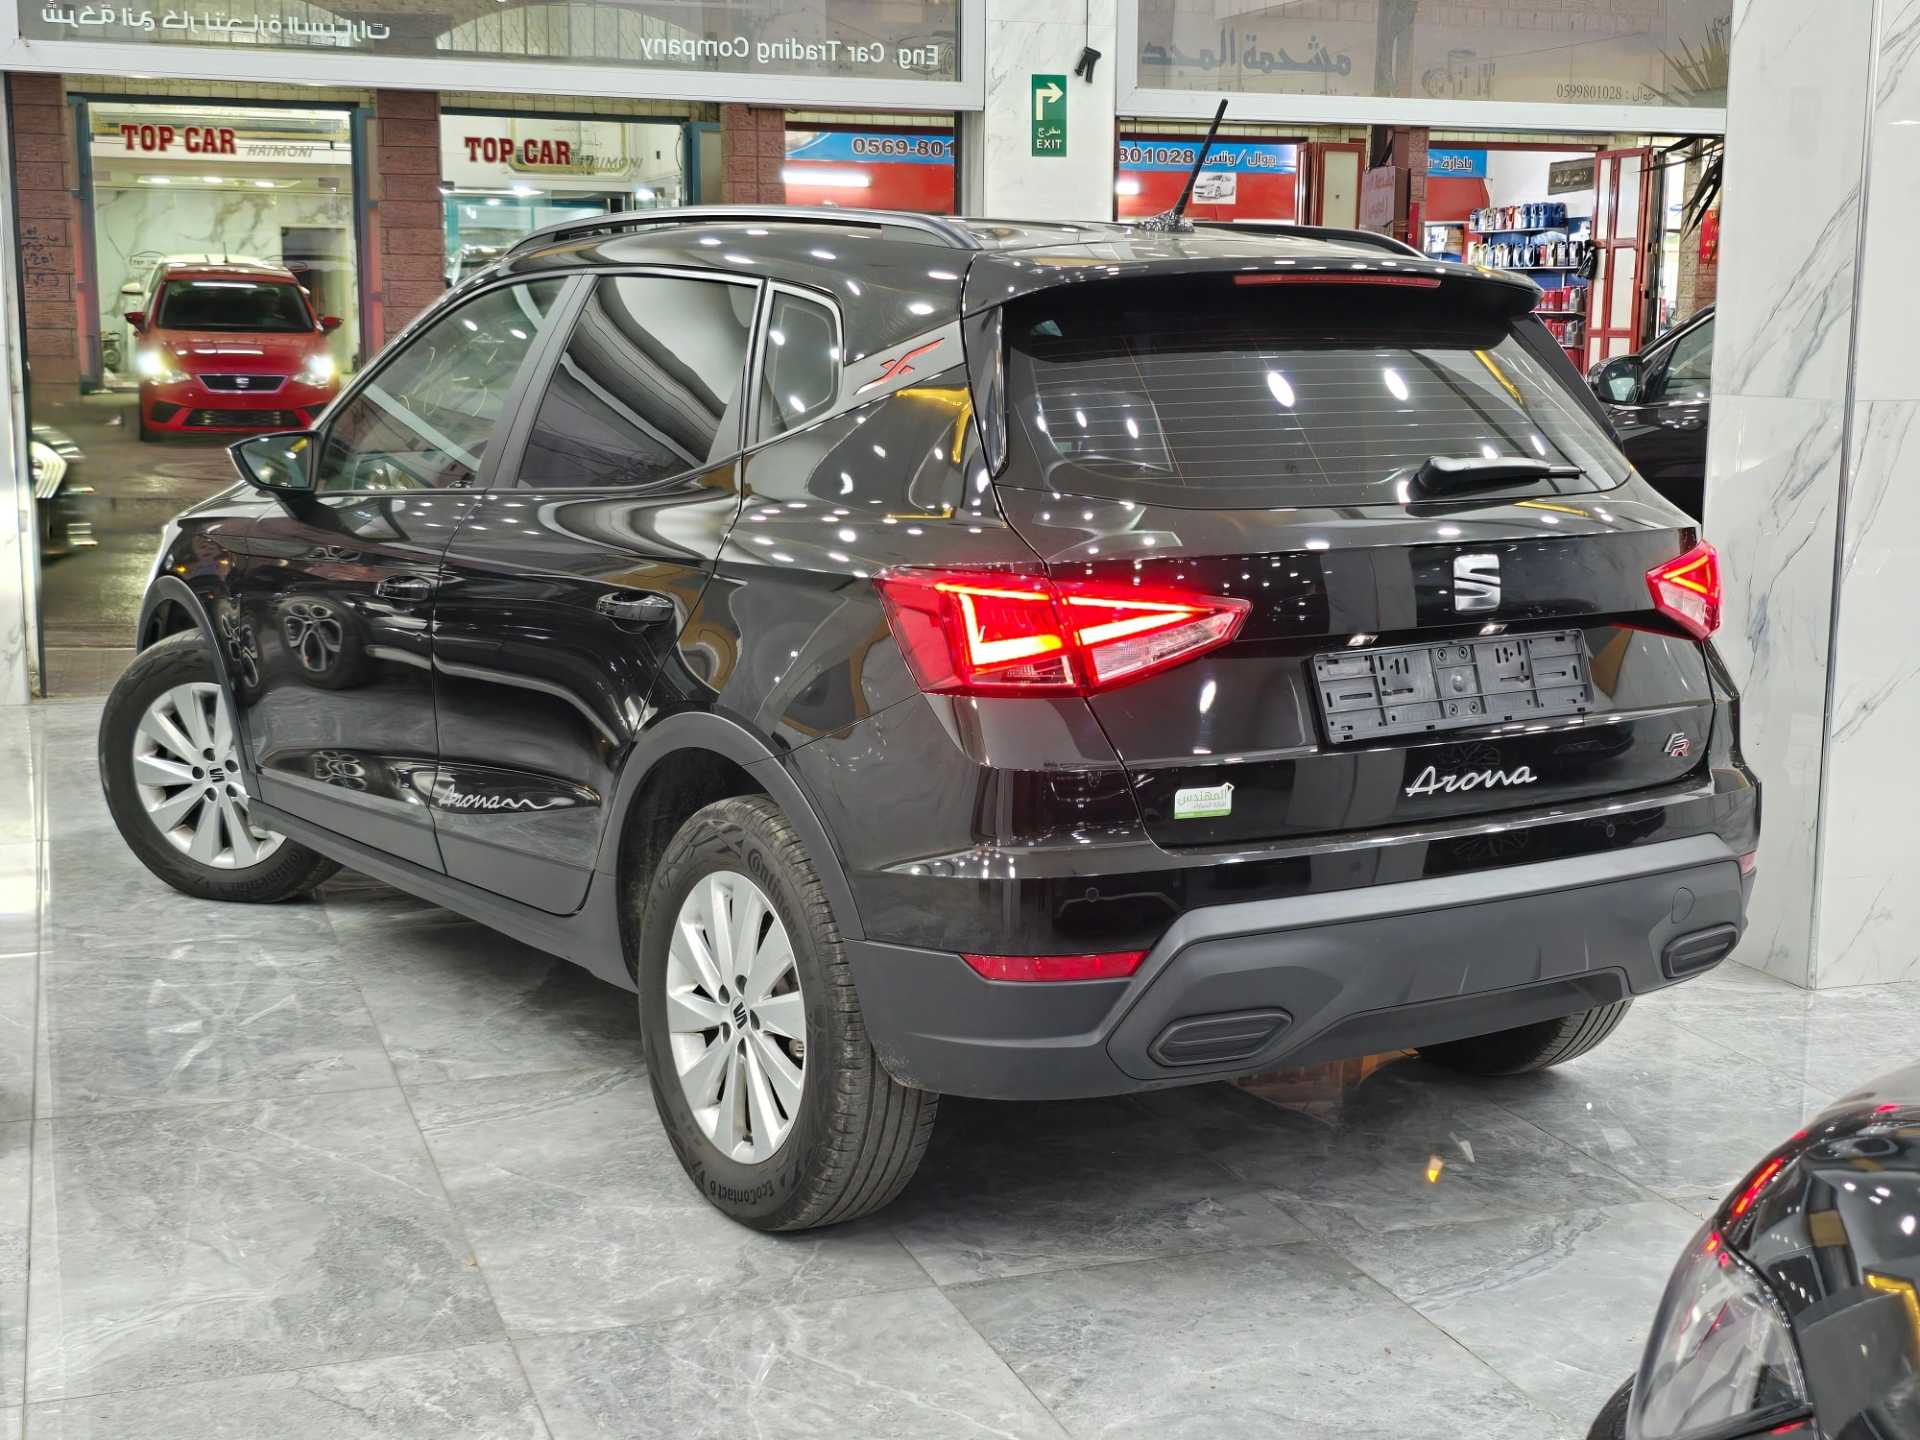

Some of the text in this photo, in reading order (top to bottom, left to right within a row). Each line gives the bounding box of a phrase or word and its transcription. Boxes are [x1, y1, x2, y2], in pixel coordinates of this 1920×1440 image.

[1243, 32, 1353, 77] مشحمة
[1556, 82, 1623, 99] 0599801028
[120, 124, 238, 155] TOP CAR
[464, 136, 572, 165] TOP CAR
[1036, 139, 1062, 149] EXIT
[1405, 765, 1538, 798] Arona
